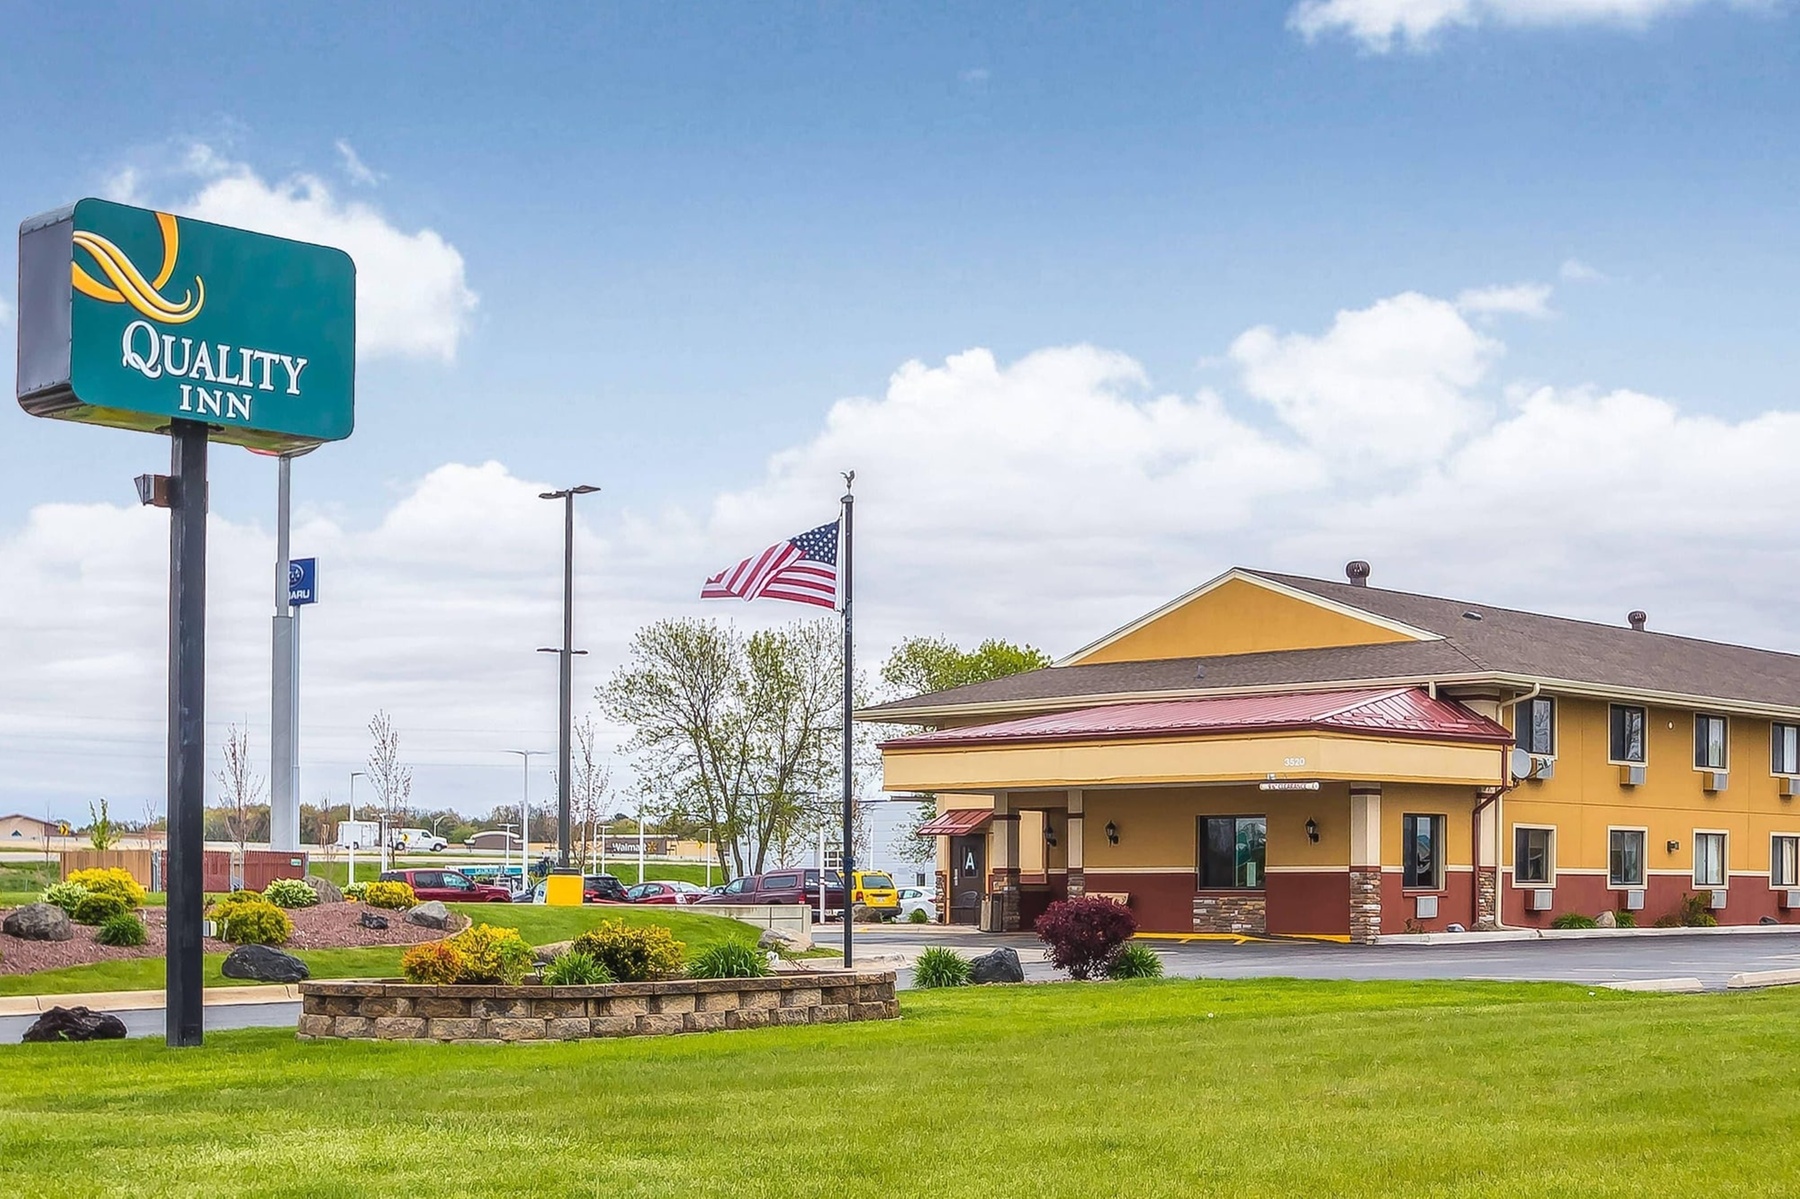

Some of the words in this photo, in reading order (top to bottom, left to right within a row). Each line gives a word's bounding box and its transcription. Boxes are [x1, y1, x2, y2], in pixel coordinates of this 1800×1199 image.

[122, 320, 308, 395] QUALITY
[179, 385, 251, 420] INN
[289, 589, 310, 599] ARU
[1284, 757, 1305, 766] 3520
[612, 843, 647, 851] Walmat
[965, 852, 975, 869] A
